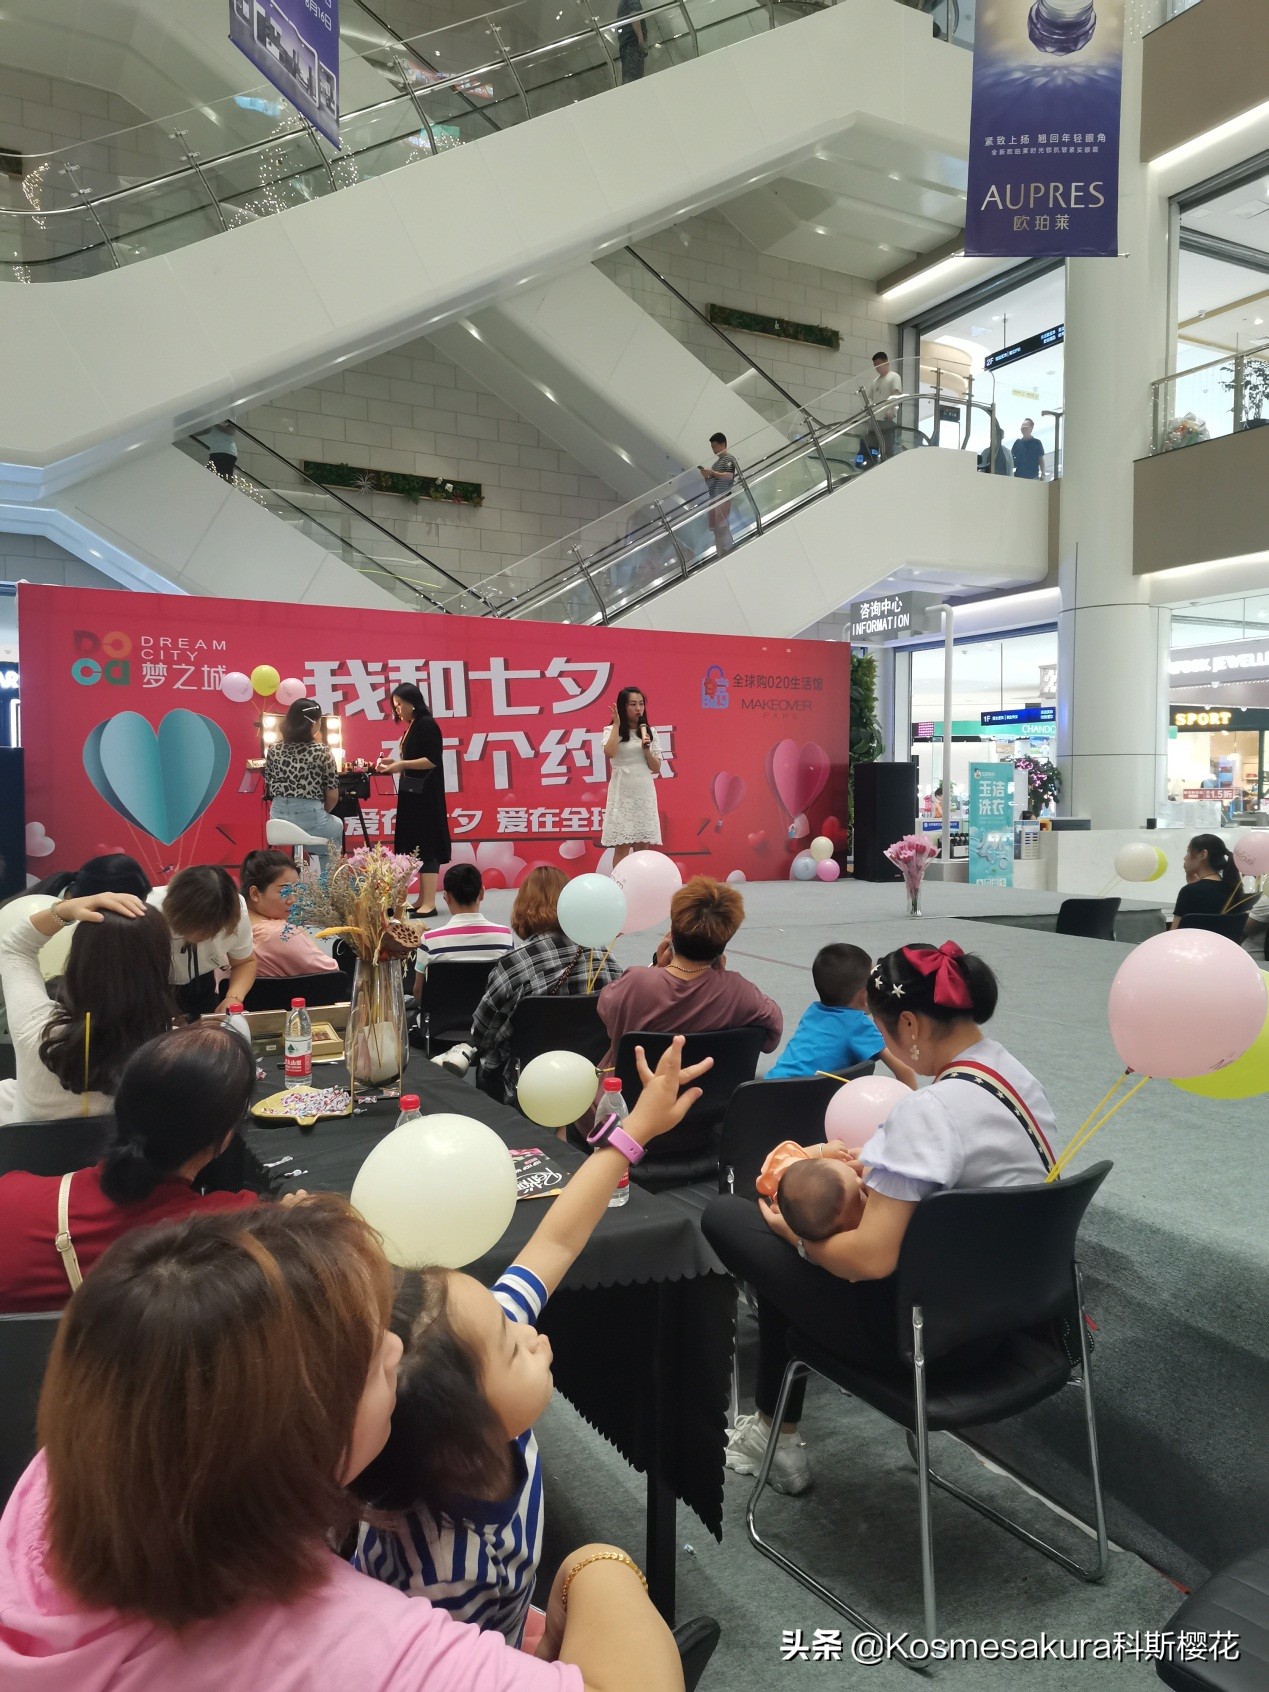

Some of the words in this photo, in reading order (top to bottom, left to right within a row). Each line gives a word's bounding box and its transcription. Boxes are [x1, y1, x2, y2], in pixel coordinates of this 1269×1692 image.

[984, 134, 1030, 146] 紧致上扬
[980, 181, 1105, 211] AUPRES
[1013, 214, 1071, 231] 欧珀莱
[860, 596, 903, 620] 咨询中心
[852, 613, 910, 636] INFORMATION
[141, 636, 227, 651] DREAM
[141, 649, 198, 662] CITY
[142, 661, 227, 691] 梦之城
[304, 656, 612, 721] 我和七夕
[741, 698, 813, 712] MAKEOVER
[1175, 711, 1232, 726] SPORT
